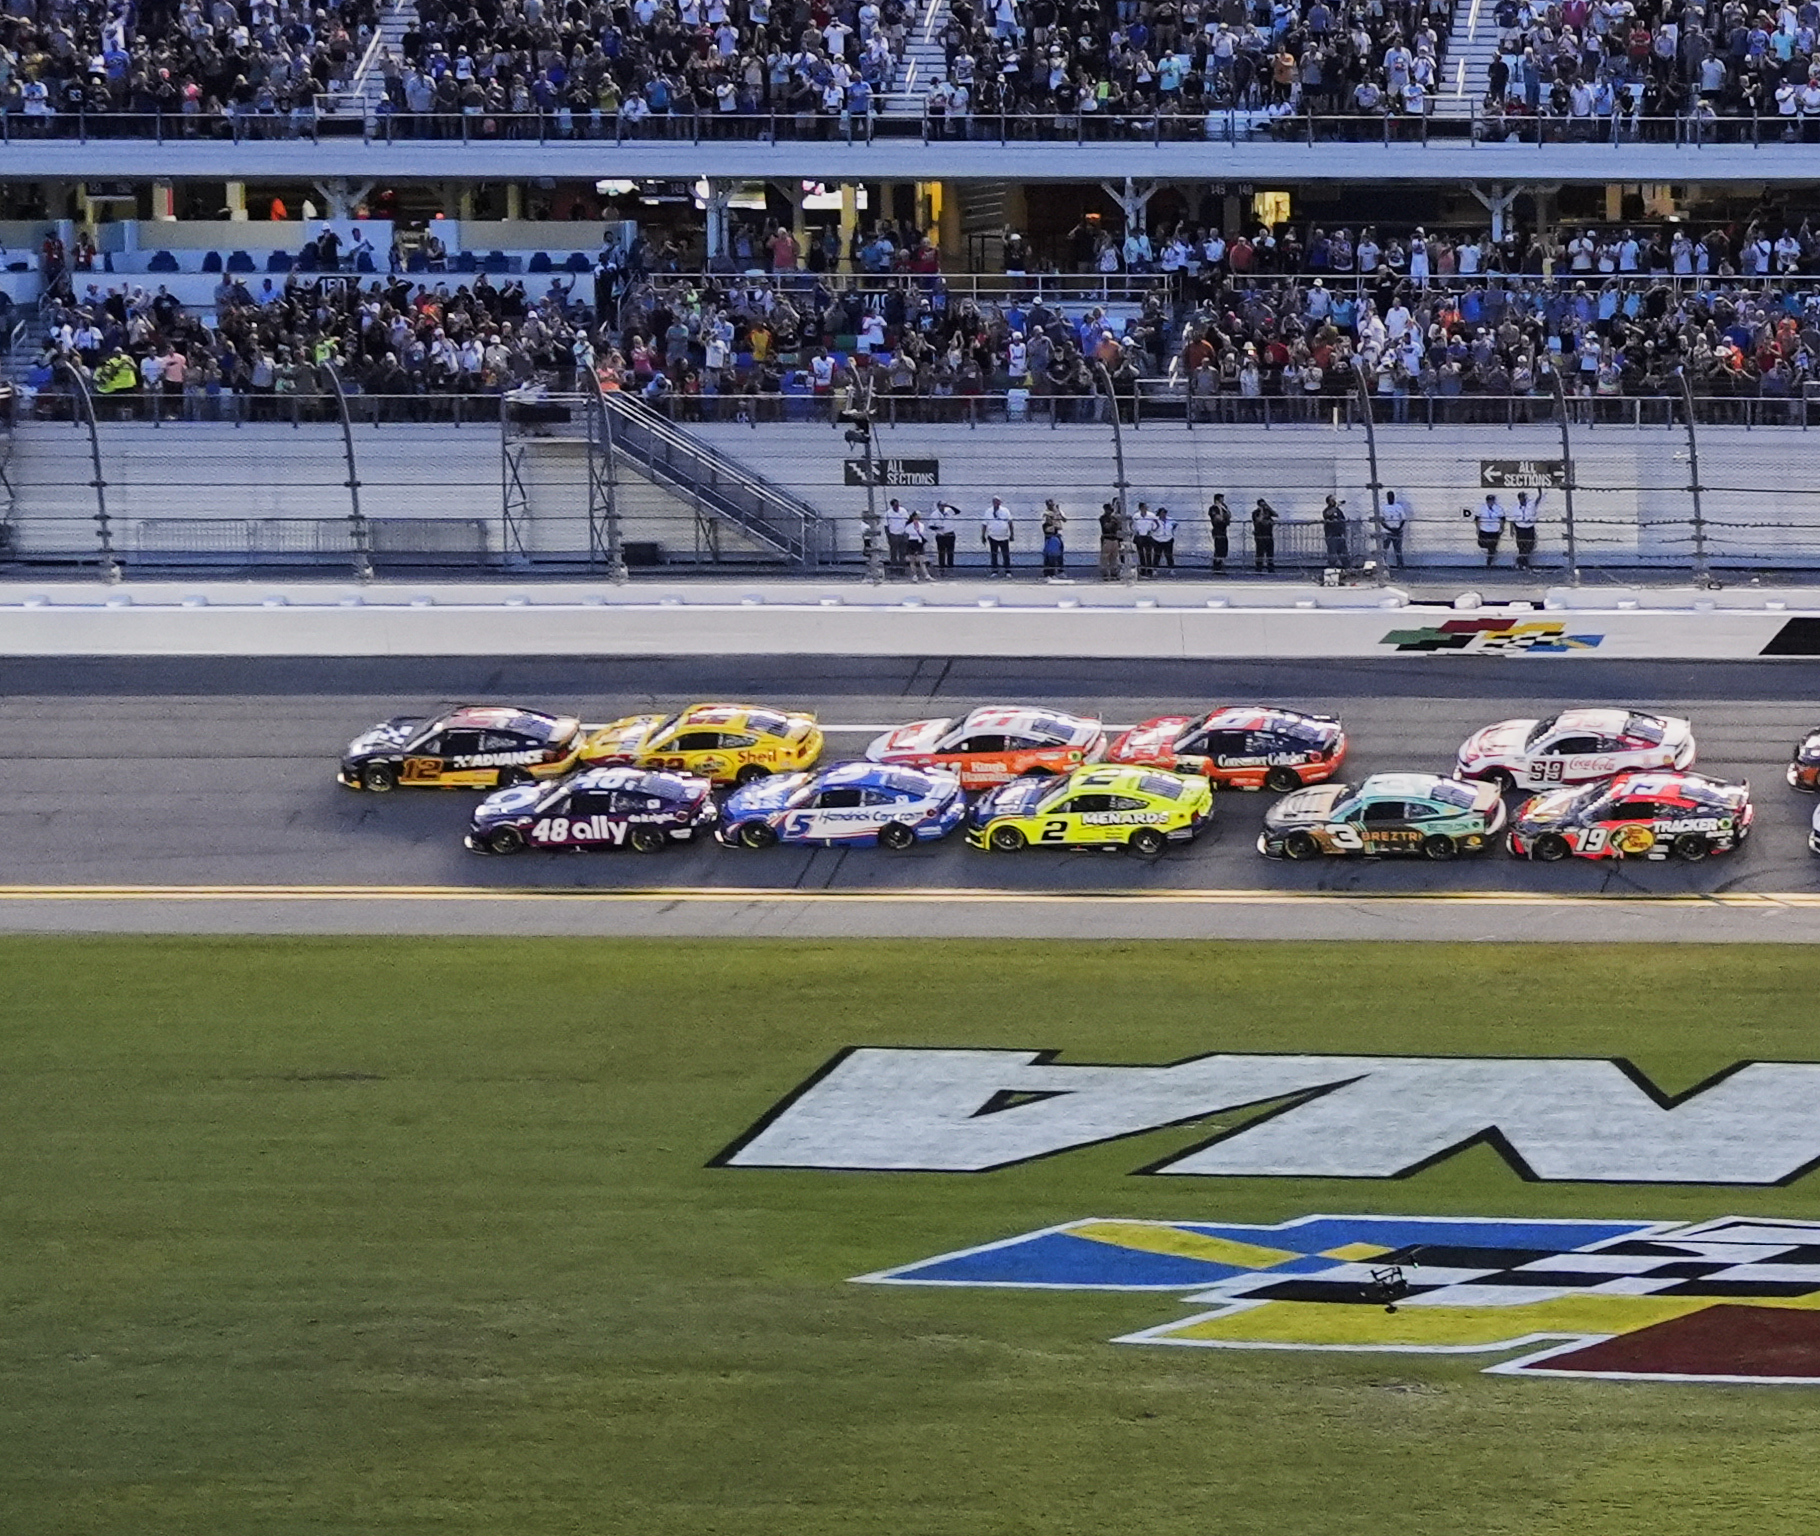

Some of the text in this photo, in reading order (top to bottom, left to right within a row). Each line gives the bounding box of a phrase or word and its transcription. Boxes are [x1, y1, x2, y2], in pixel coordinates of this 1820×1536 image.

[887, 460, 905, 472] ALL
[1519, 460, 1537, 473] ALL
[886, 472, 936, 485] SECTIONS
[1504, 474, 1552, 488] SECTIONS
[470, 748, 544, 768] ADVANCE
[738, 751, 777, 766] Shell
[1218, 754, 1268, 768] Consumer
[402, 757, 443, 782] 12
[785, 809, 817, 837] 5
[1082, 810, 1170, 826] MENARDS
[1653, 817, 1719, 834] TRACKER
[532, 815, 629, 846] 48 ally
[1042, 821, 1068, 841] 2
[1324, 823, 1364, 850] 3
[1575, 828, 1609, 852] 19
